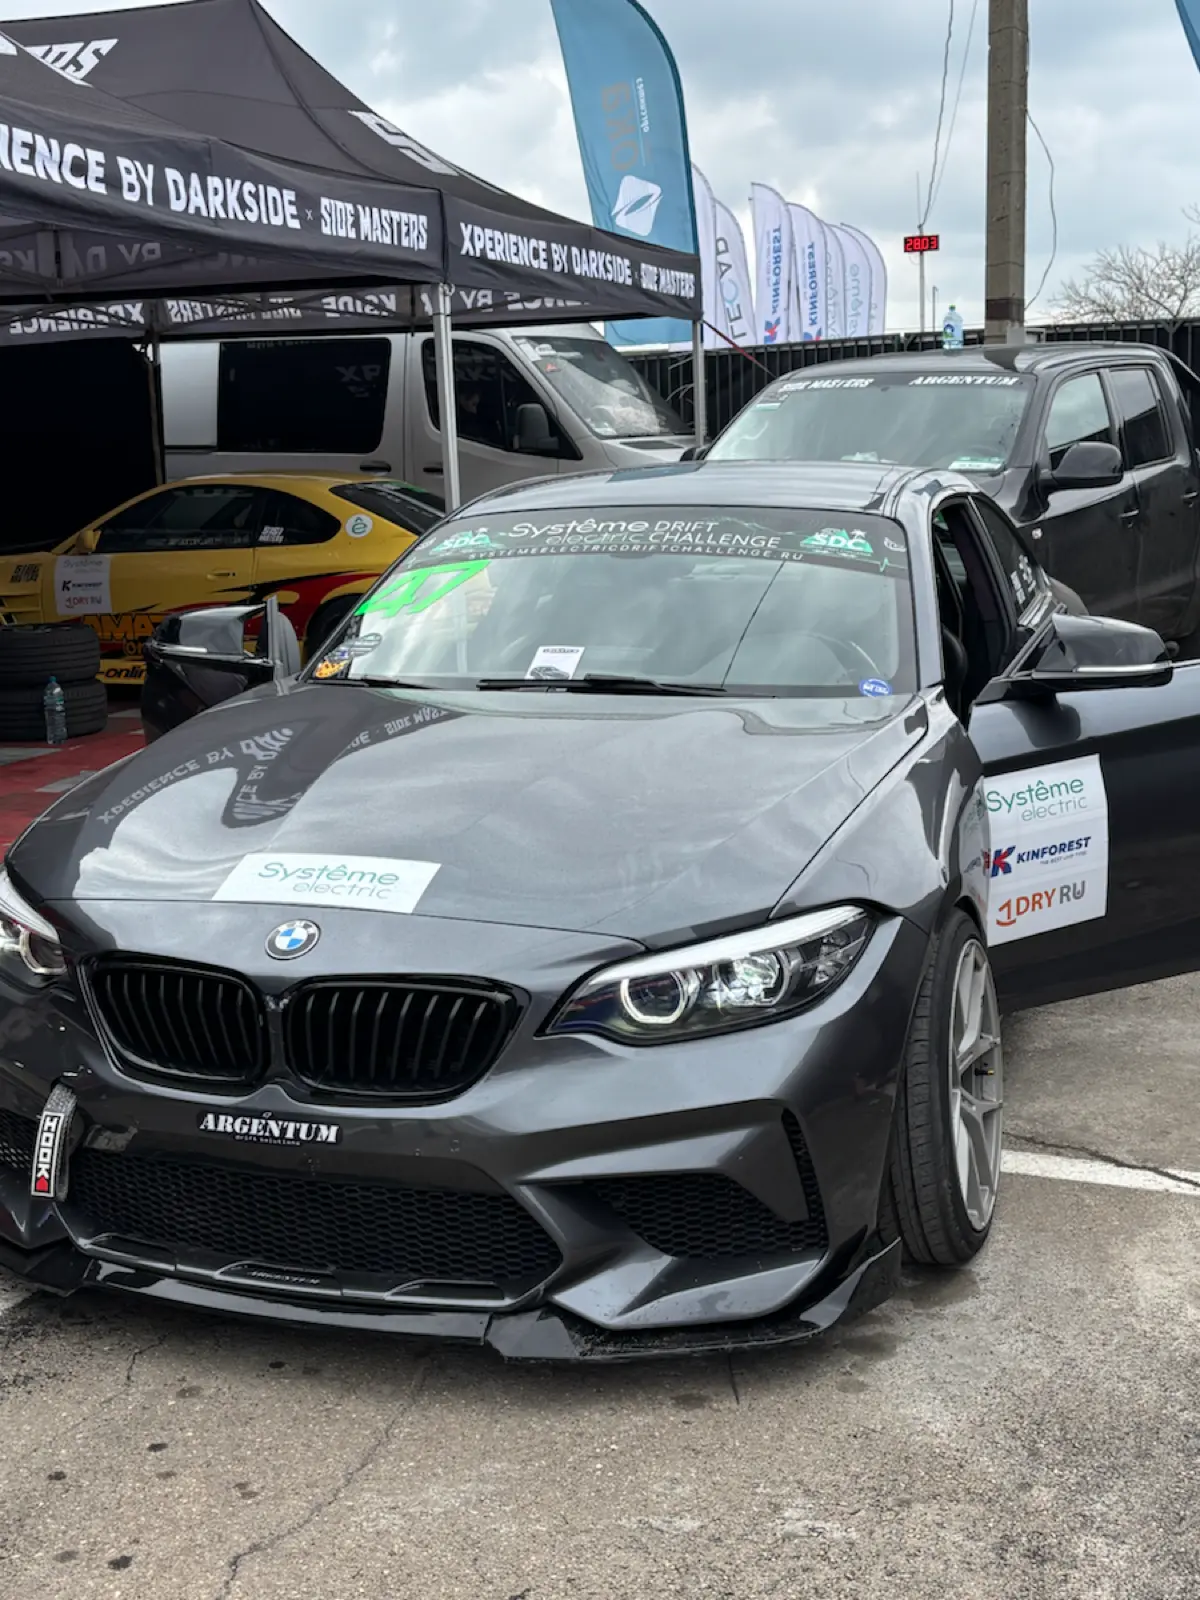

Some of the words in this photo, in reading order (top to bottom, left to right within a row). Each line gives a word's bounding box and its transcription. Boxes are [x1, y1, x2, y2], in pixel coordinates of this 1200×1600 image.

[0, 123, 107, 195] IENCE
[116, 156, 154, 206] BY
[165, 168, 301, 229] DARKSIDE
[320, 197, 356, 239] SIDE
[357, 204, 428, 251] MASTERS
[460, 222, 548, 270] XPERIENCE
[551, 243, 568, 273] BY
[572, 247, 632, 285] DARKSIDE
[660, 268, 695, 299] MASTERS
[908, 376, 1020, 386] ARGENTUM
[654, 520, 719, 533] DRIFT
[545, 532, 644, 545] electric
[649, 532, 781, 549] CHALLENGE
[812, 533, 866, 551] SDC
[1021, 795, 1088, 822] electric
[1016, 836, 1092, 864] KINFOREST
[293, 878, 393, 900] electric
[1059, 881, 1086, 904] RU
[200, 1112, 339, 1143] ARGENTUM
[37, 1116, 58, 1179] HOOK
